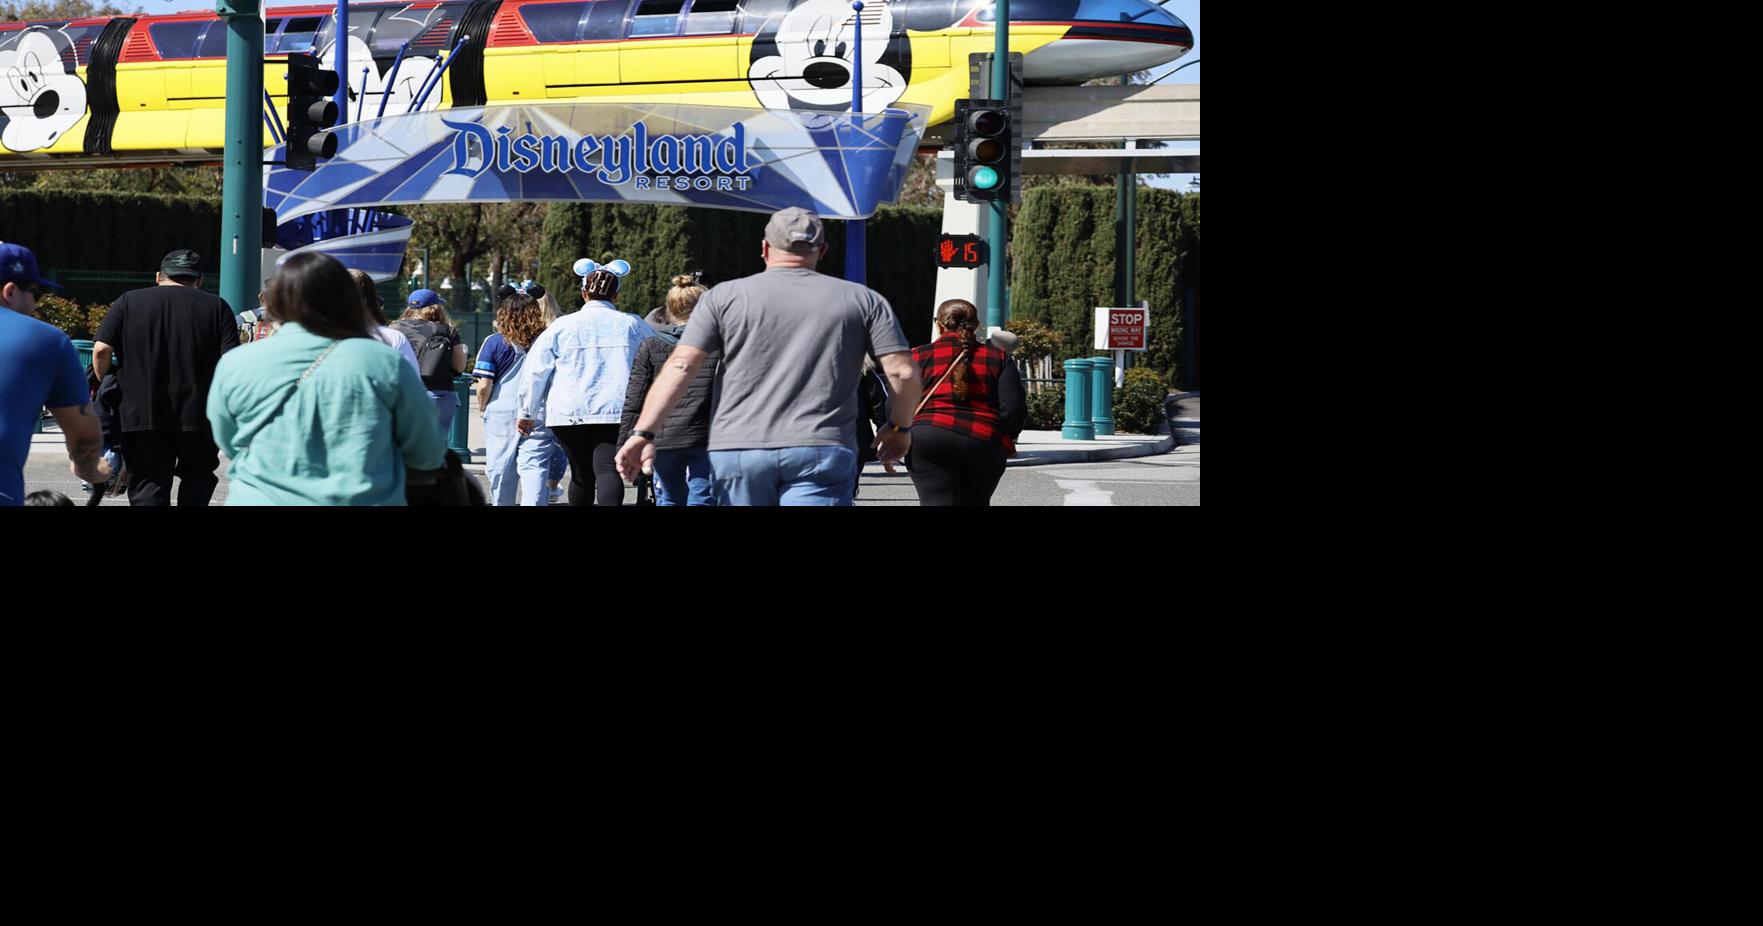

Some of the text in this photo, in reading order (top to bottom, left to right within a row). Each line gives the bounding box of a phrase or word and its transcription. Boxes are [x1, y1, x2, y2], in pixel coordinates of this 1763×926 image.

[441, 116, 751, 184] Disneyland
[635, 175, 750, 191] RESORT
[964, 242, 977, 262] 15
[1111, 313, 1142, 325] STOP
